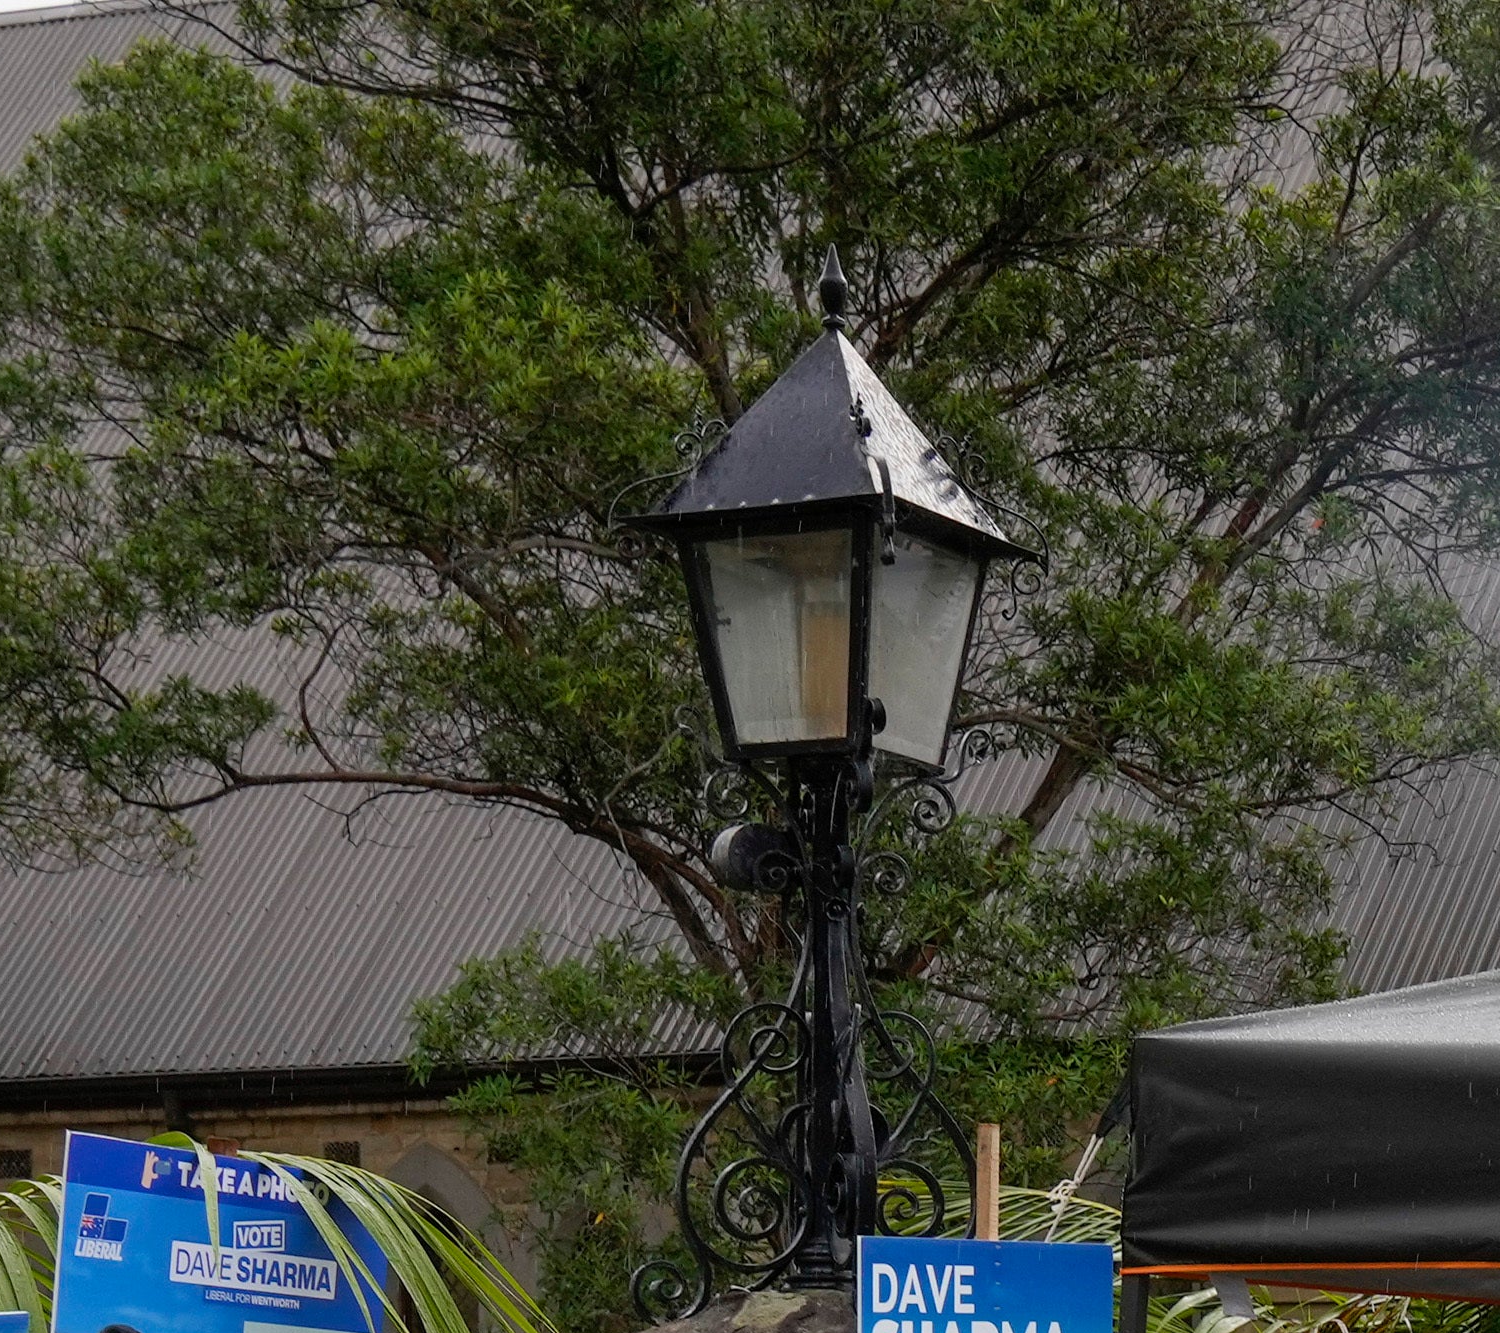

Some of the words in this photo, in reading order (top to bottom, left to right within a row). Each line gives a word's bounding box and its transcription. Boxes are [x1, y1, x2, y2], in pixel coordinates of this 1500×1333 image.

[238, 1171, 254, 1197] A
[237, 1227, 282, 1248] VOTE
[74, 1239, 122, 1261] LIBERAL
[176, 1248, 233, 1281] DAVE
[237, 1256, 331, 1293] SHARMA
[205, 1290, 234, 1302] LIBERAL
[252, 1296, 300, 1310] WENTWORTH
[872, 1264, 975, 1314] DAVE
